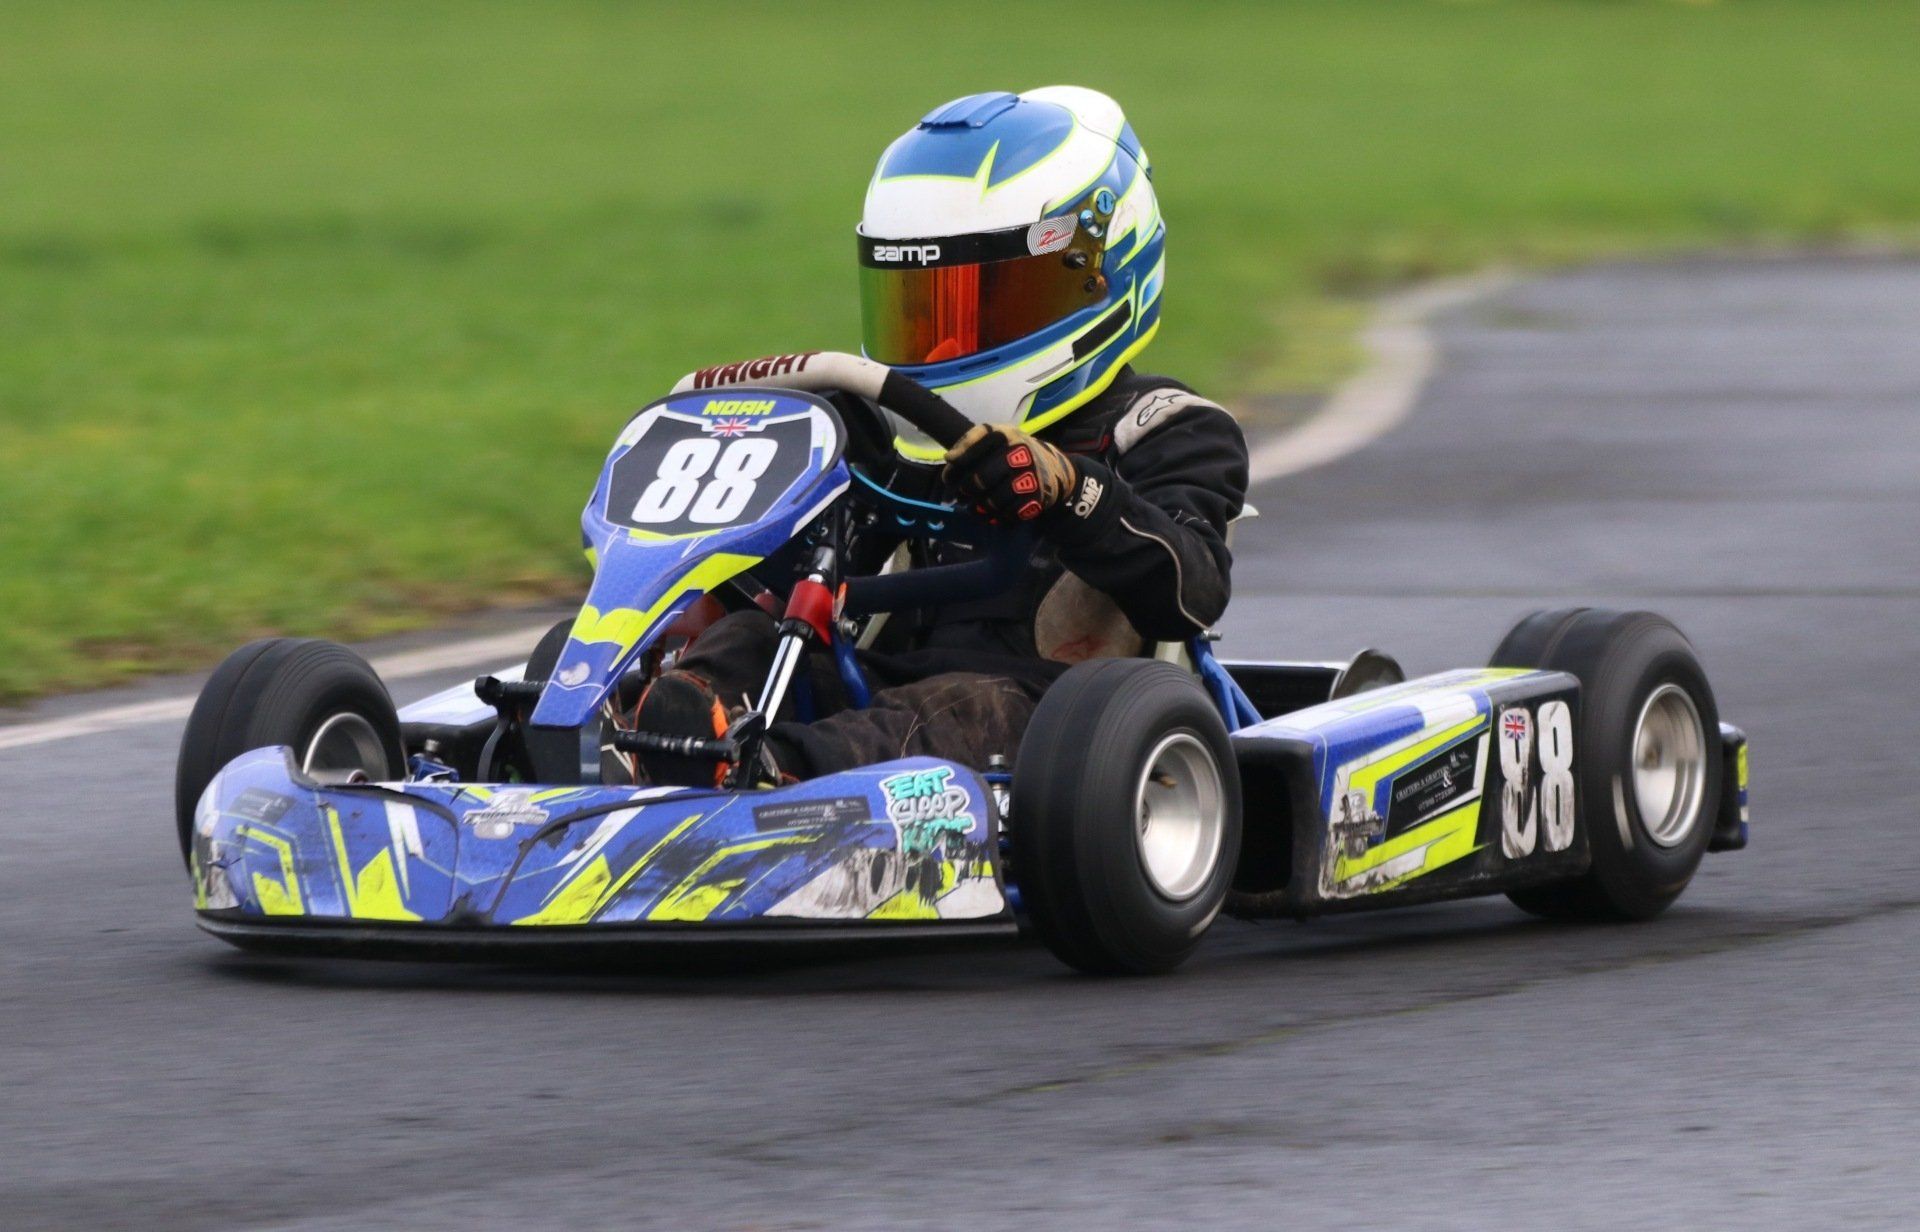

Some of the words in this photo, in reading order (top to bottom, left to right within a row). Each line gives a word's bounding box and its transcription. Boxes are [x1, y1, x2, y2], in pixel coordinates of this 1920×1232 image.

[873, 244, 941, 267] zamp
[693, 352, 822, 389] WRIGHT
[702, 400, 776, 416] NOAH
[630, 437, 779, 524] 88
[1075, 477, 1102, 517] OMP
[885, 768, 951, 800] EAT
[1498, 700, 1575, 859] 88
